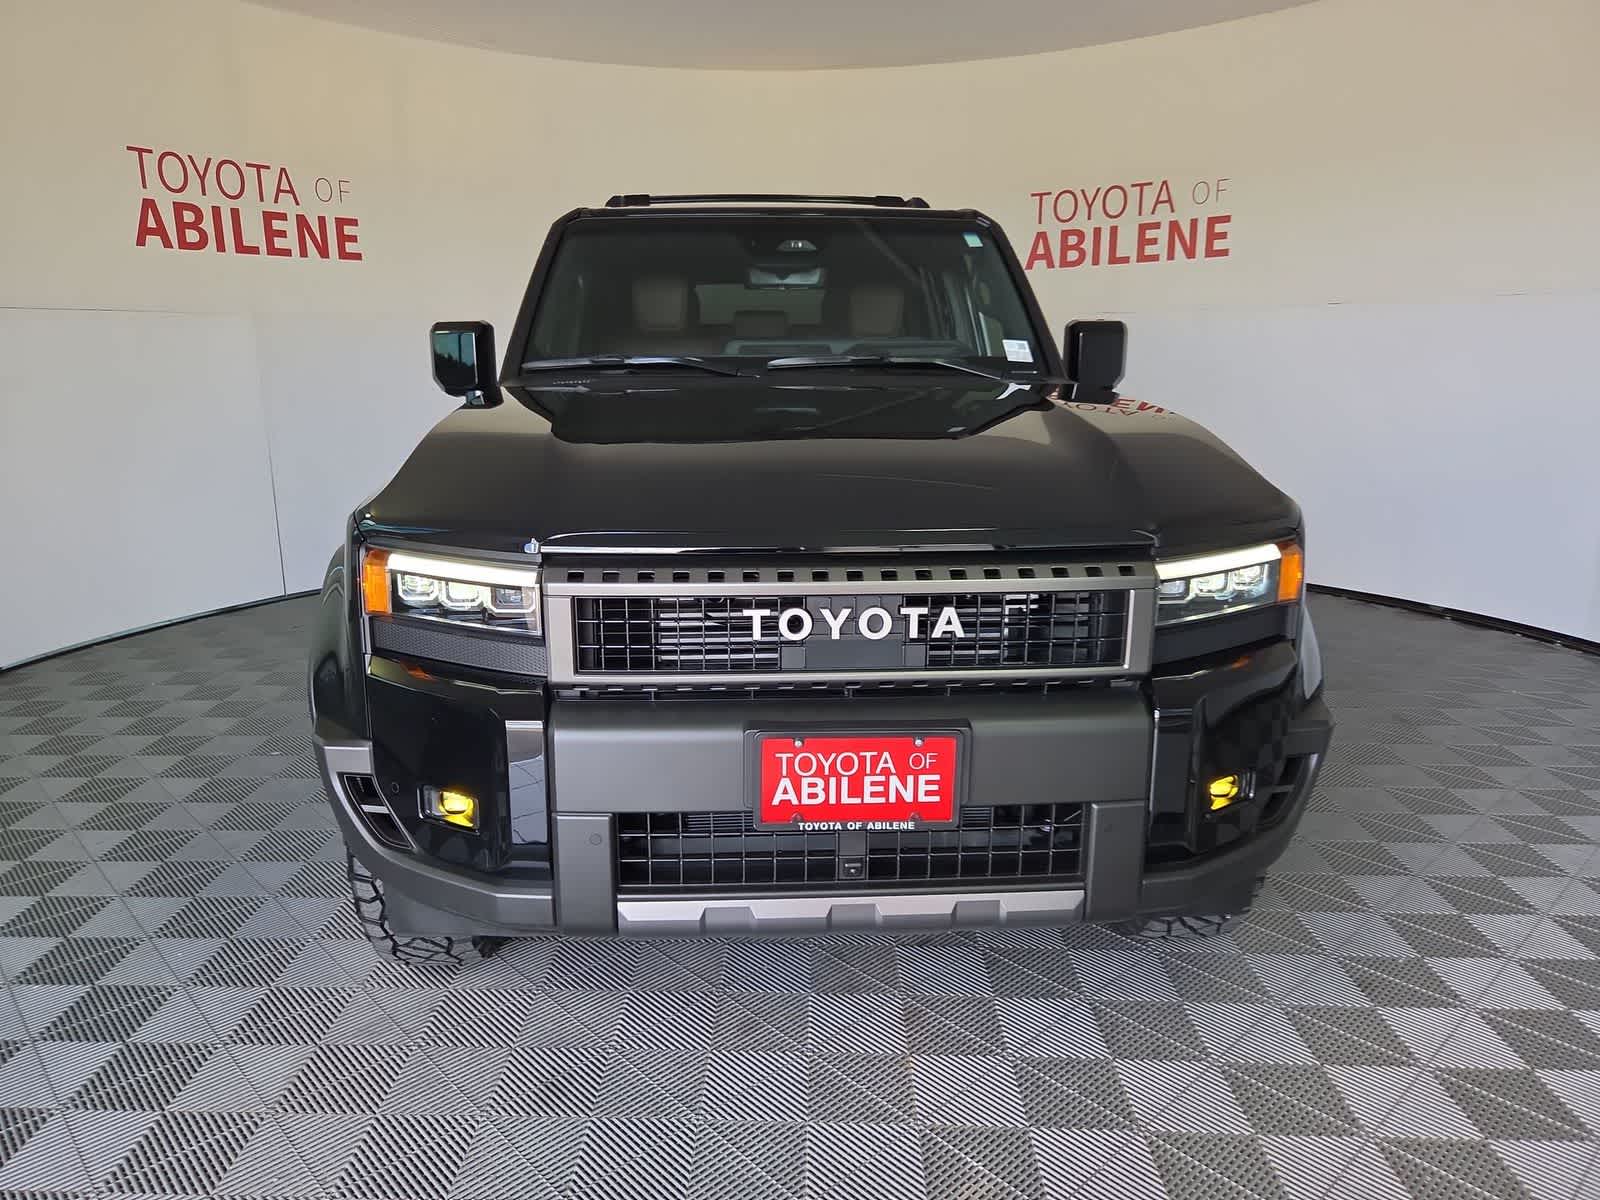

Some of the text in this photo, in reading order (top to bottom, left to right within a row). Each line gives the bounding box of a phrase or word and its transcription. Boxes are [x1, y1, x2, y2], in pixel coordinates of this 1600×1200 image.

[126, 145, 350, 206] TOYOTA OF
[1030, 178, 1230, 224] TOYOTA OF
[135, 197, 362, 261] ABILENE
[1024, 214, 1232, 270] ABILENE
[742, 606, 965, 641] TOYOTA
[775, 751, 938, 776] TOYOTA OF
[771, 774, 941, 806] ABILENE
[798, 821, 915, 831] TOYOTA OF ABILENE
